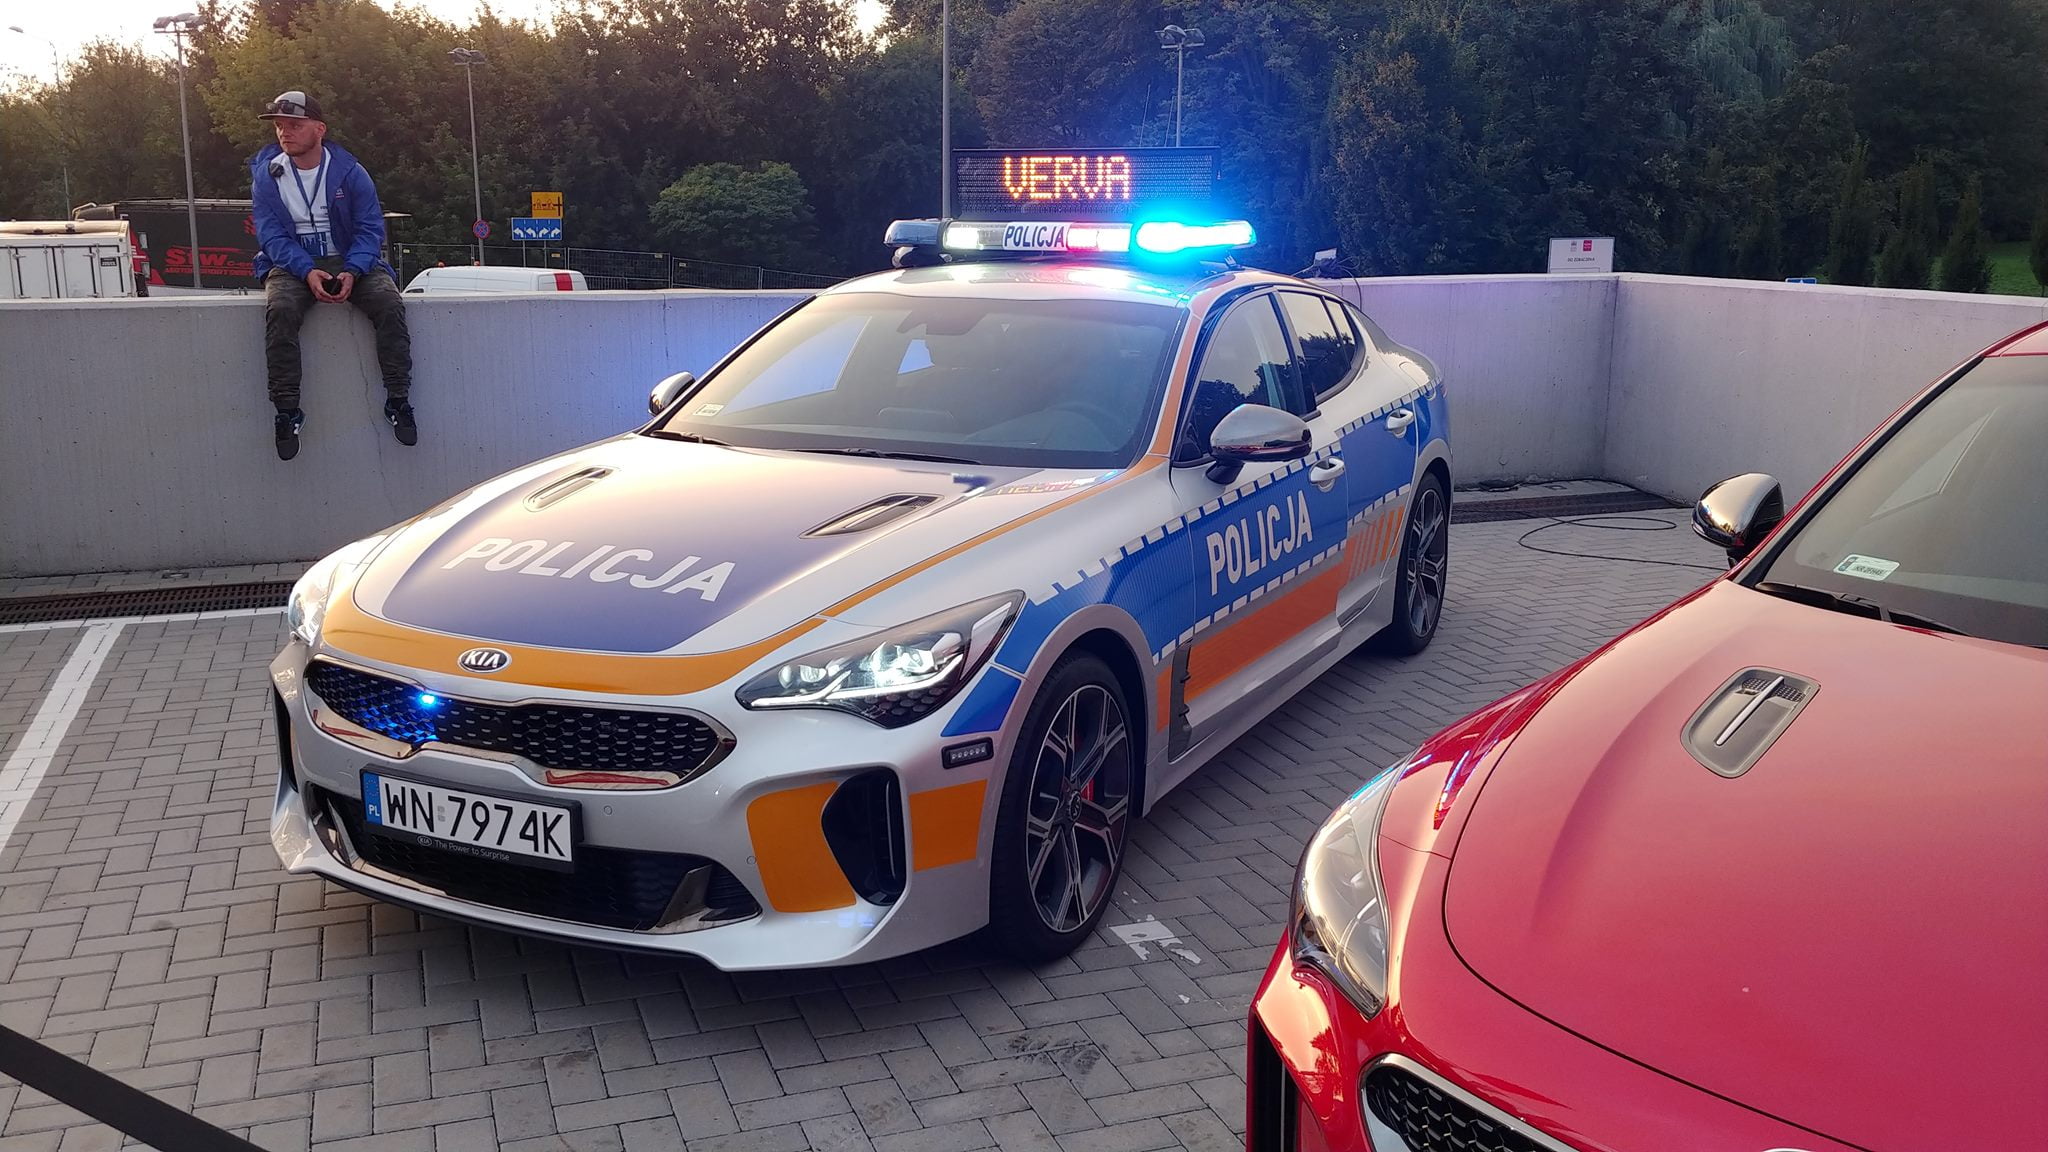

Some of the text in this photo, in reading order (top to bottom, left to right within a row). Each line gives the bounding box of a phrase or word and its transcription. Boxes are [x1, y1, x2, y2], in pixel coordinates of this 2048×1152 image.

[1003, 156, 1130, 199] VERVA
[1004, 225, 1065, 248] POLICJA
[1206, 490, 1313, 597] POLICJA
[441, 538, 736, 602] POLICJA
[463, 650, 501, 668] KIA
[368, 804, 380, 817] PL
[385, 783, 566, 857] WN 7974K
[434, 839, 448, 849] The
[449, 843, 470, 854] Power
[481, 849, 510, 861] Surprise
